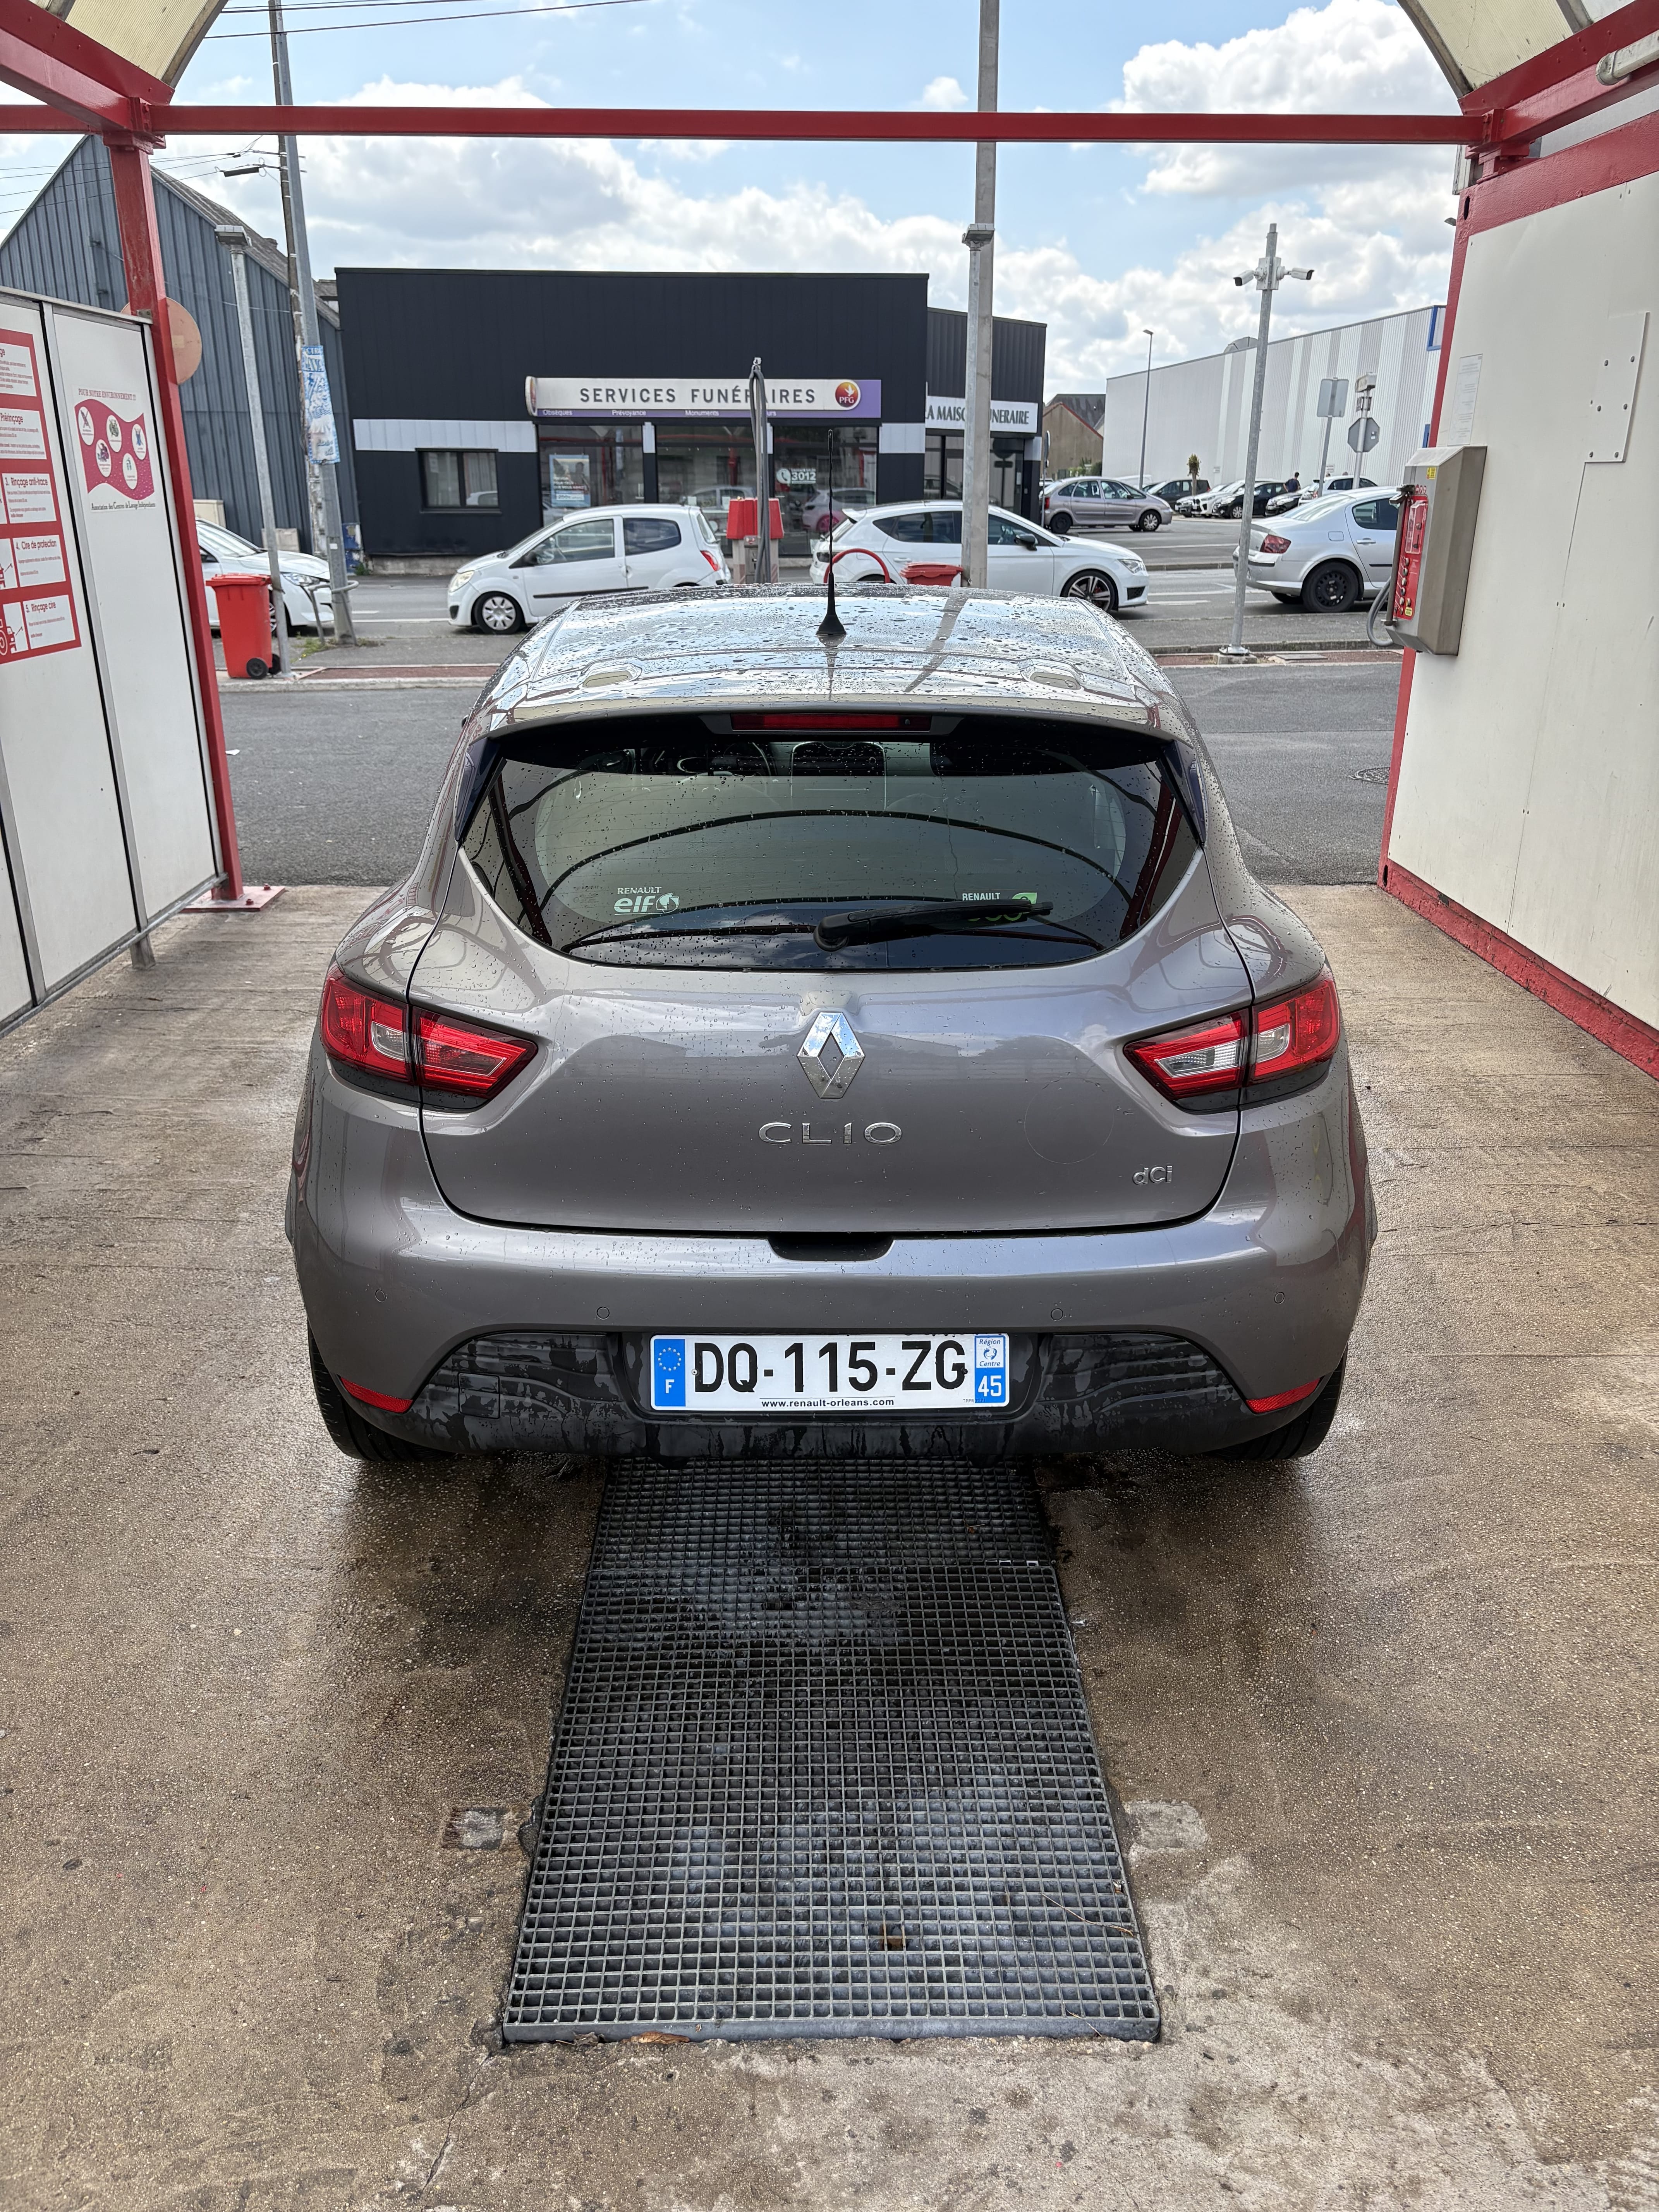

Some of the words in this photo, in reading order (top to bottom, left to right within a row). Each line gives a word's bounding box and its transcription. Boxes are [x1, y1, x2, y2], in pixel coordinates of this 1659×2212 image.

[580, 388, 676, 403] SERVICES
[691, 385, 815, 404] FUNÉRIRES
[990, 409, 1029, 424] NERAIRE
[791, 472, 816, 481] 3012
[31, 540, 36, 549] de
[614, 895, 656, 912] elf
[962, 893, 1000, 901] RENAULT
[759, 1122, 902, 1145] CLIO
[1132, 1166, 1172, 1185] dCi
[694, 1340, 965, 1393] DQ-115-ZG
[665, 1379, 675, 1393] F
[978, 1375, 1002, 1397] 45
[761, 1398, 894, 1407] www.renault-orleans.com
